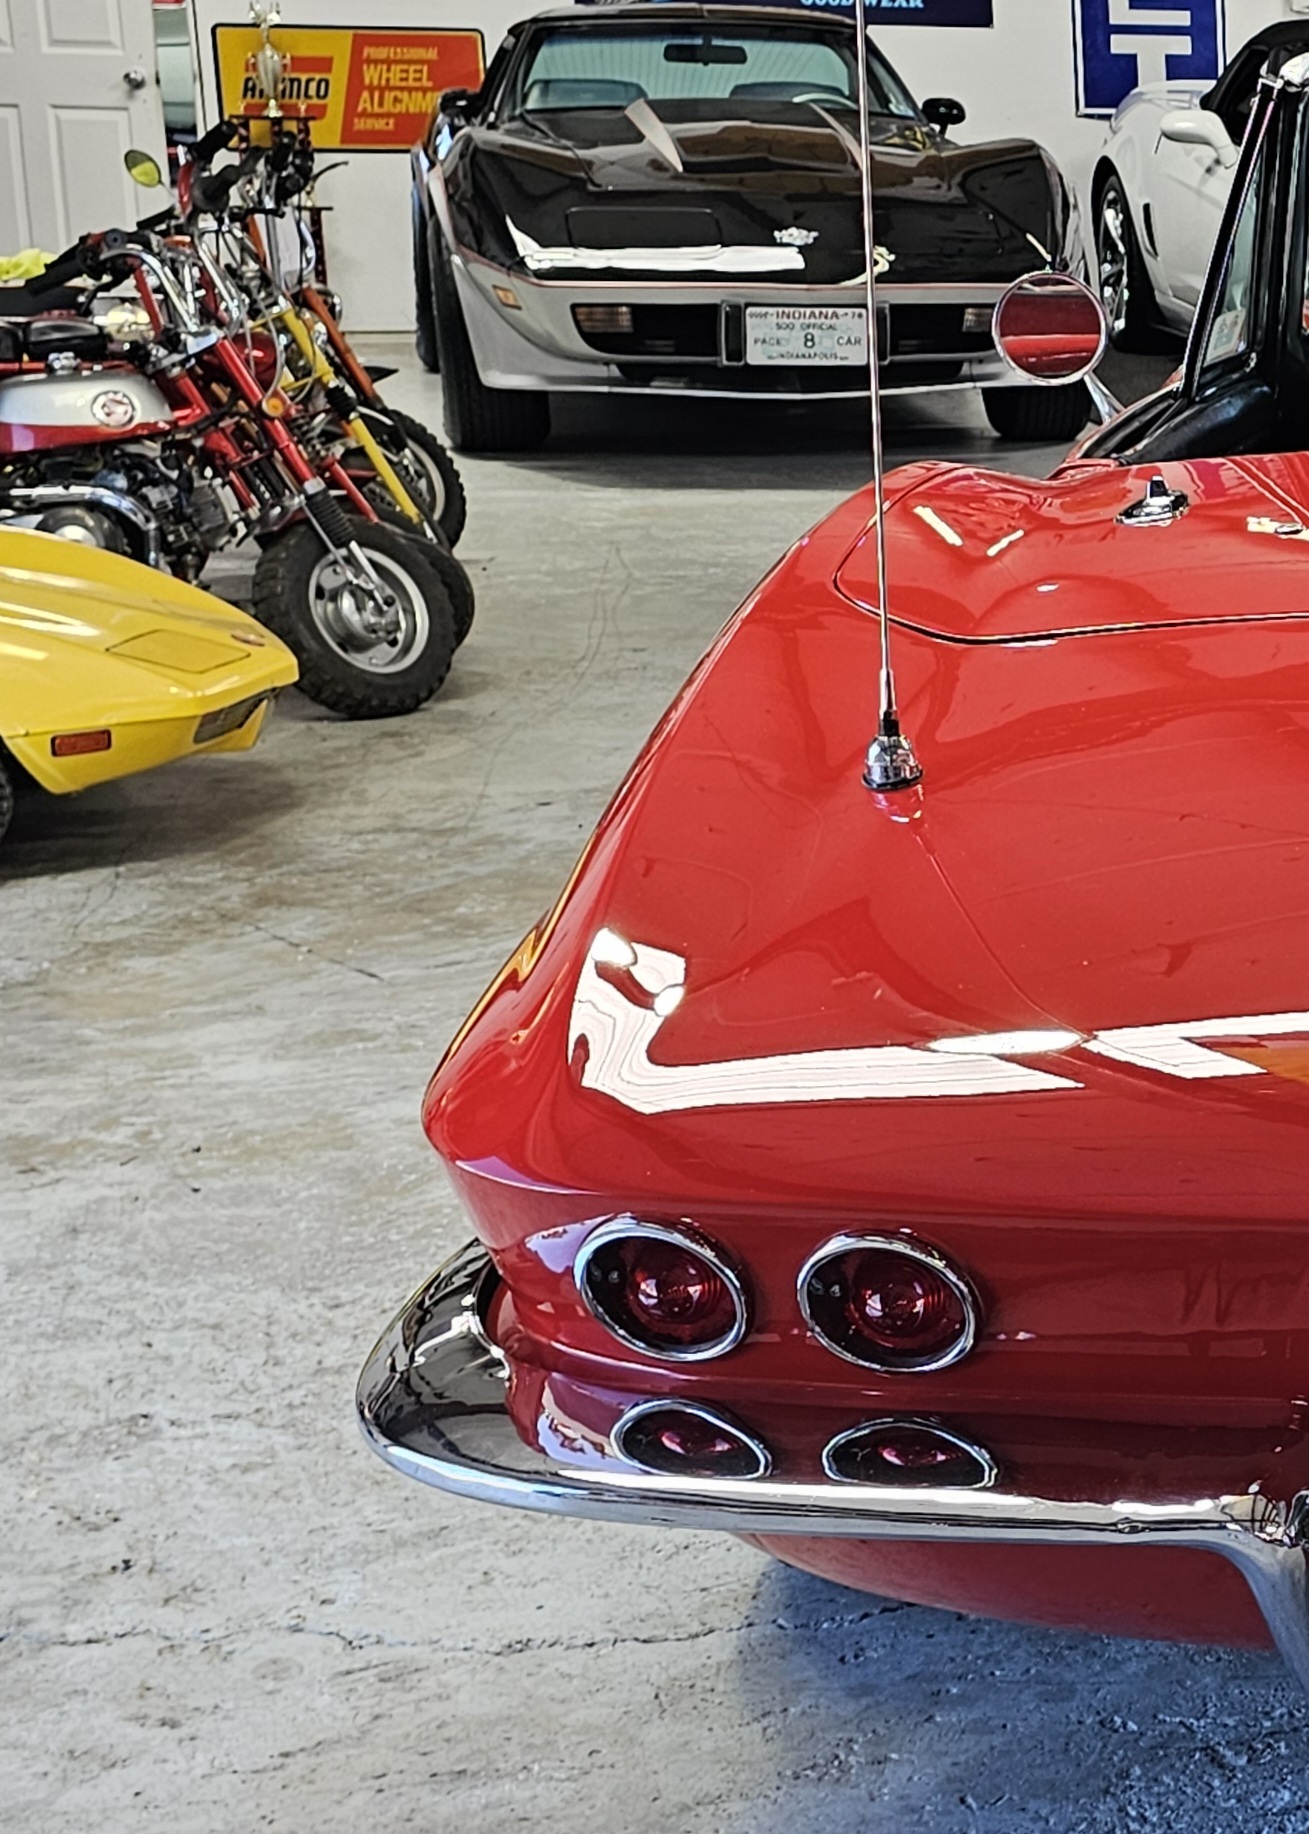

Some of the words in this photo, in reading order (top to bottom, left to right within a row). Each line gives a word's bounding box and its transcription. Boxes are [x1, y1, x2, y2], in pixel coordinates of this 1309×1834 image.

[362, 46, 438, 60] PROFESSIONAL
[363, 64, 433, 87] WHEEL
[243, 77, 330, 101] AMCO
[776, 310, 840, 320] INDIANA
[804, 332, 816, 349] 8
[837, 336, 862, 346] CAR
